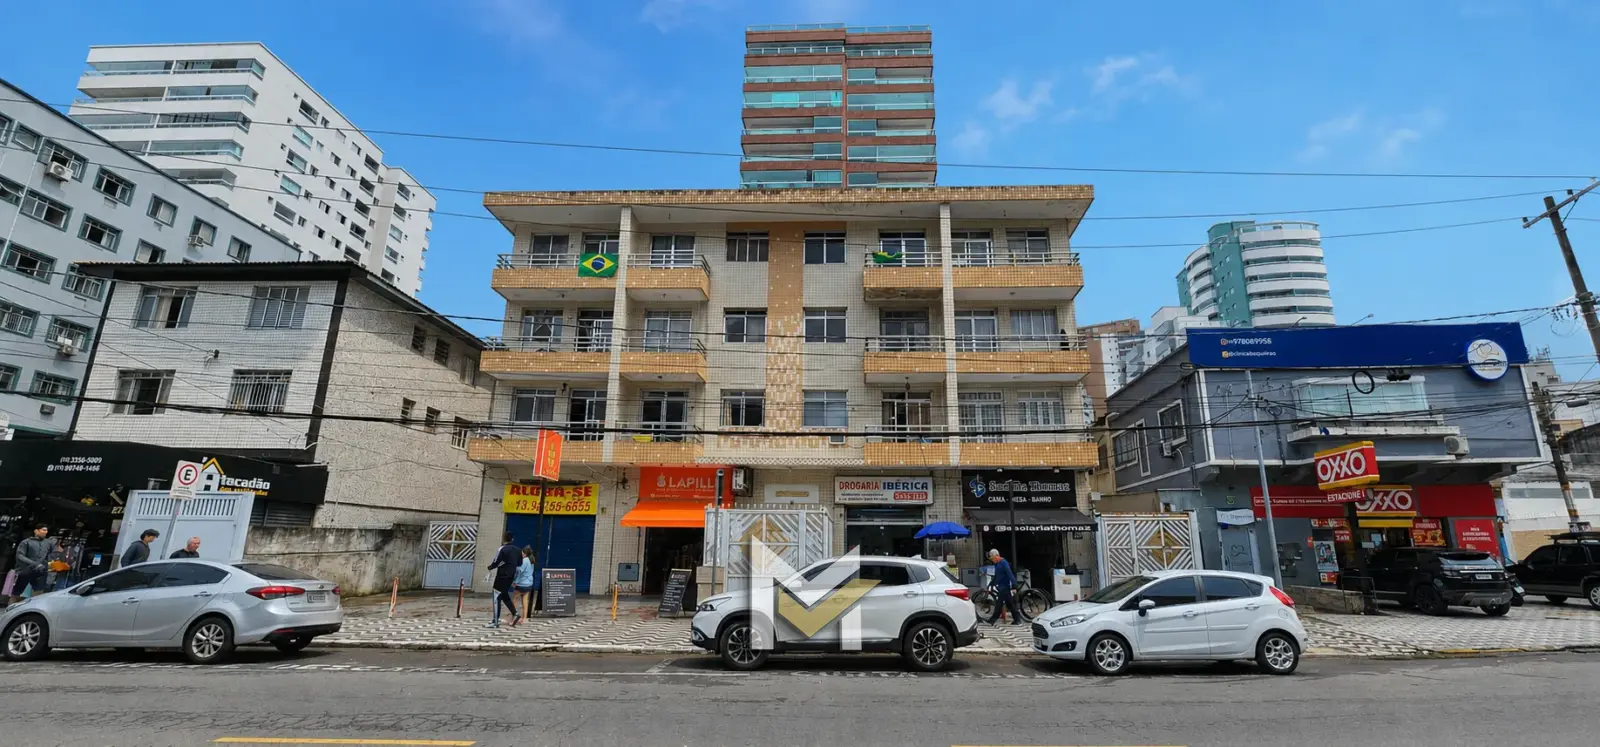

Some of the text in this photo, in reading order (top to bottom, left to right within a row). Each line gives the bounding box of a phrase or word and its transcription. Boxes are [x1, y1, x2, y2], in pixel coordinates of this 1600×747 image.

[1317, 450, 1366, 483] OXXO
[184, 469, 193, 481] E
[669, 476, 717, 489] LAPILL
[839, 479, 928, 490] DROGARIA IBÉRICA
